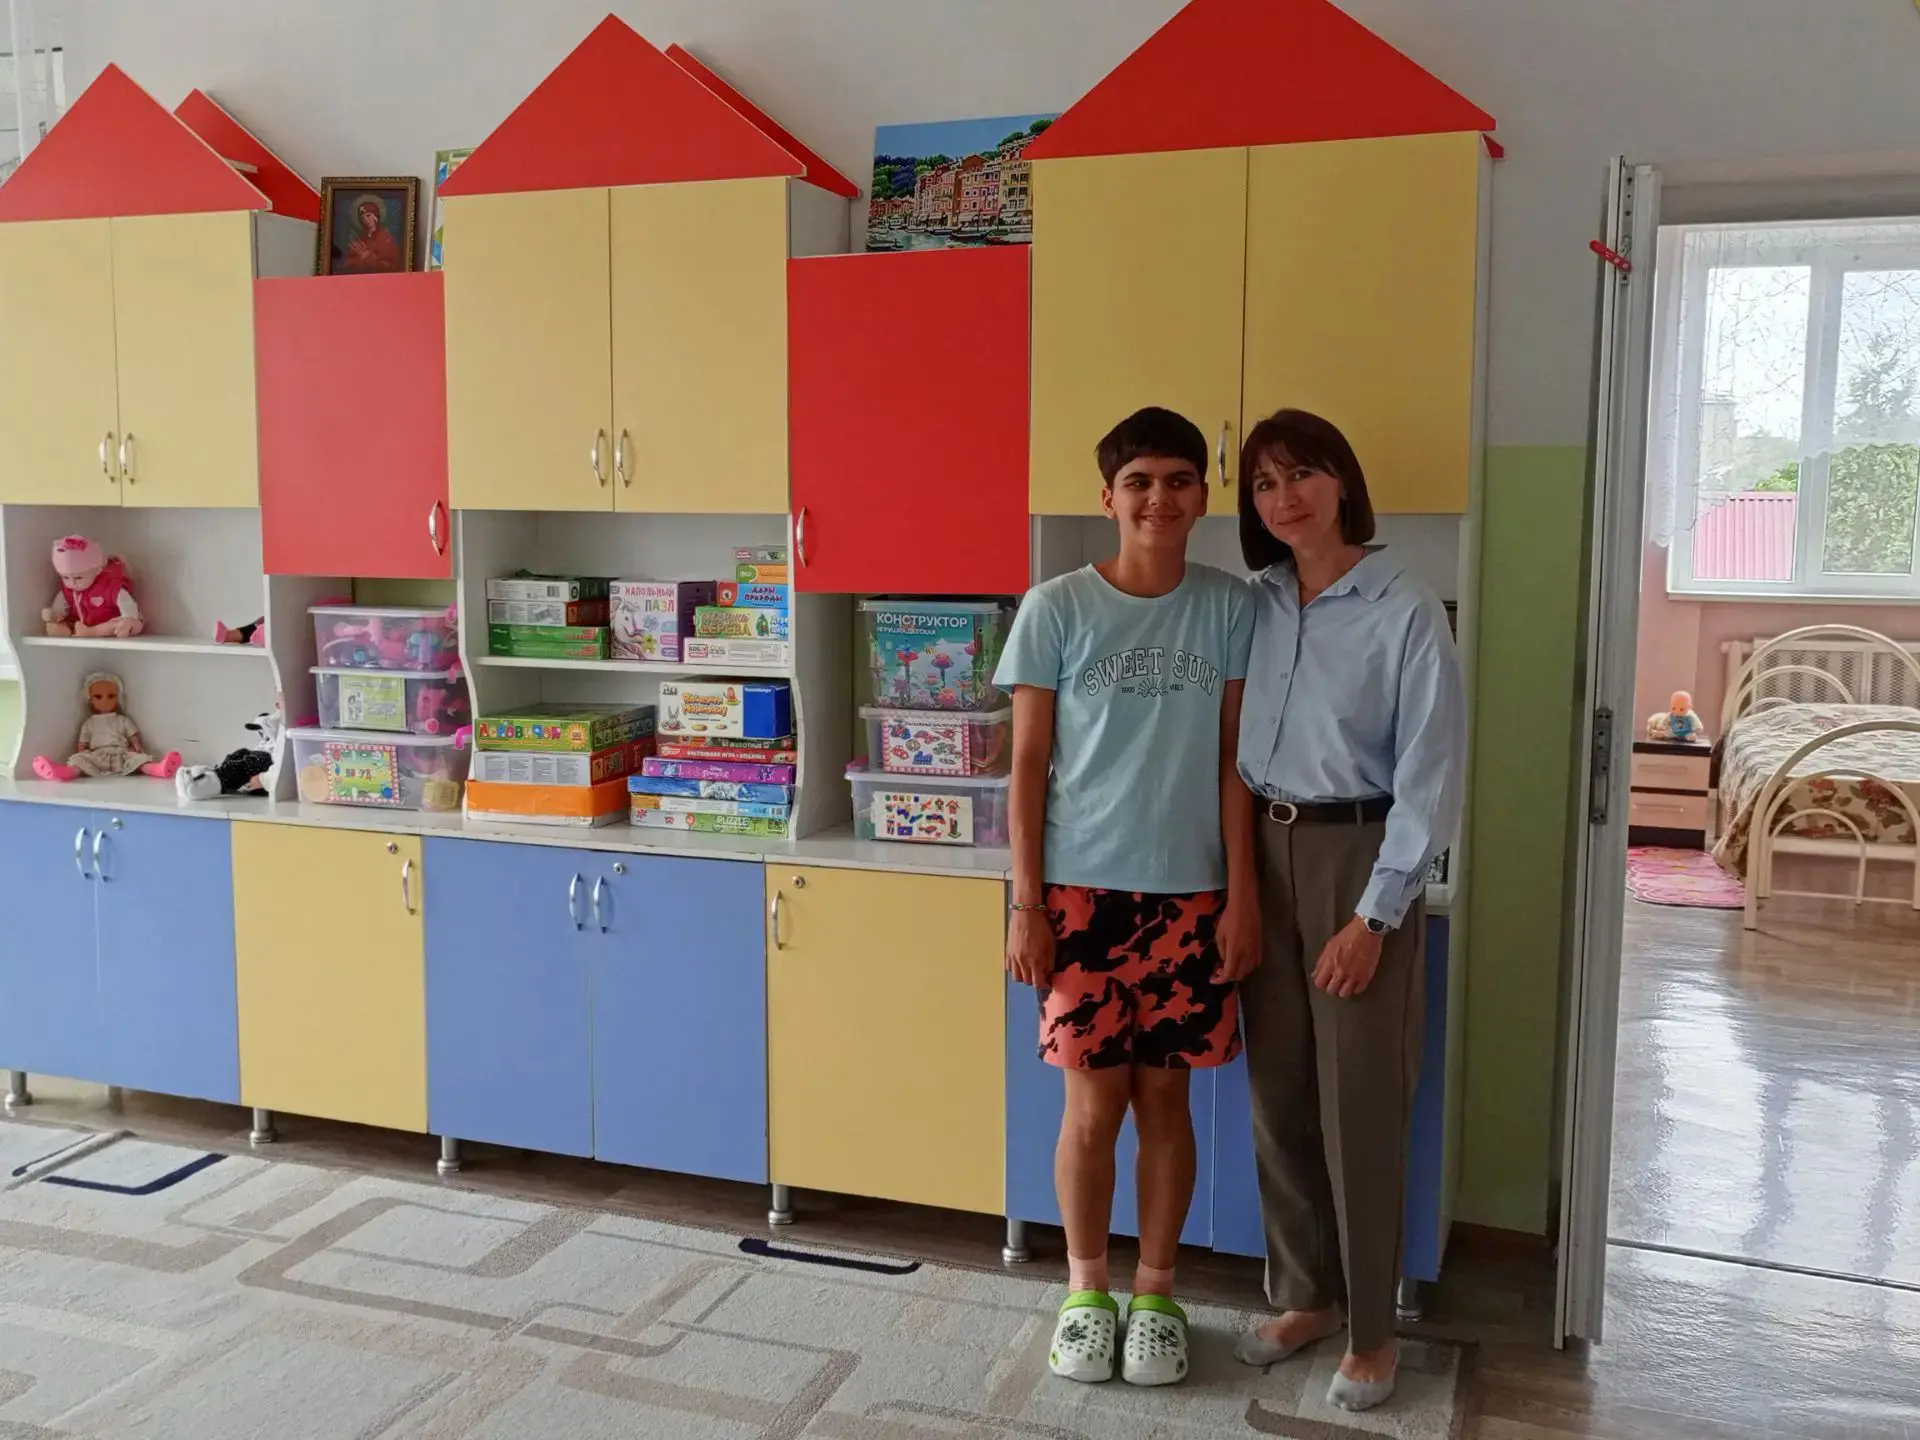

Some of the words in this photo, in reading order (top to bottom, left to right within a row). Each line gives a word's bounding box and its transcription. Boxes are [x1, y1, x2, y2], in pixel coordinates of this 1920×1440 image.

[625, 586, 675, 597] НАПОЛЬНЫЙ
[645, 599, 675, 612] ПАЗЛ
[876, 612, 968, 628] КОНСТРУКТОР
[1083, 647, 1164, 696] SWEET
[1173, 649, 1219, 697] SUN
[716, 815, 750, 828] PUZZLE
